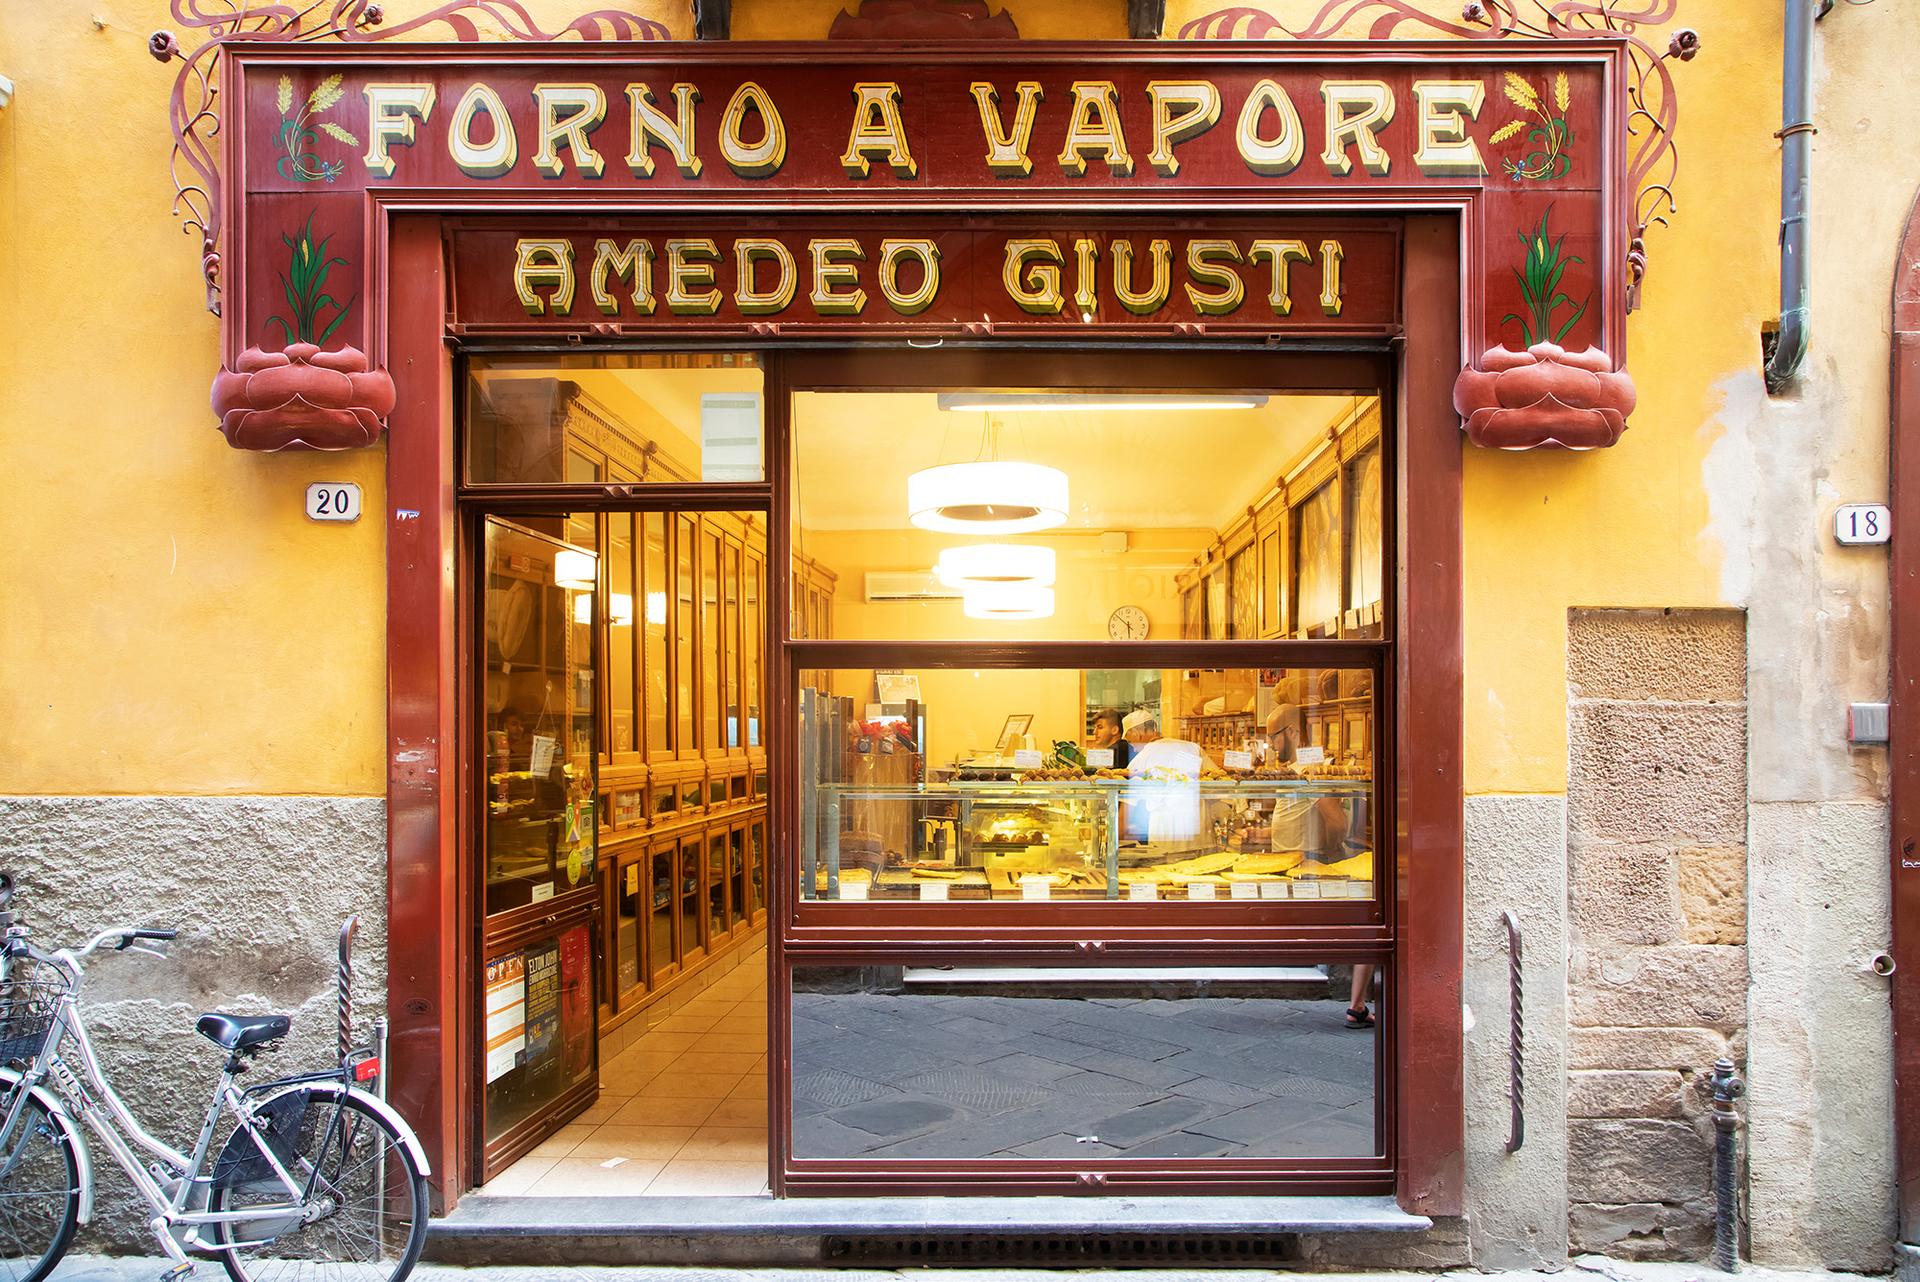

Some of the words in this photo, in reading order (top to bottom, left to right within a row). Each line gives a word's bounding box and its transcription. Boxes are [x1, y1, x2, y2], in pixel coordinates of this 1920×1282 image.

[362, 81, 789, 178] FORNO
[839, 80, 918, 177] A
[970, 79, 1487, 178] VAPORE
[513, 238, 943, 316] AMEDEO
[1002, 239, 1343, 316] GIUSTI
[316, 489, 348, 514] 20
[1850, 510, 1878, 537] 18
